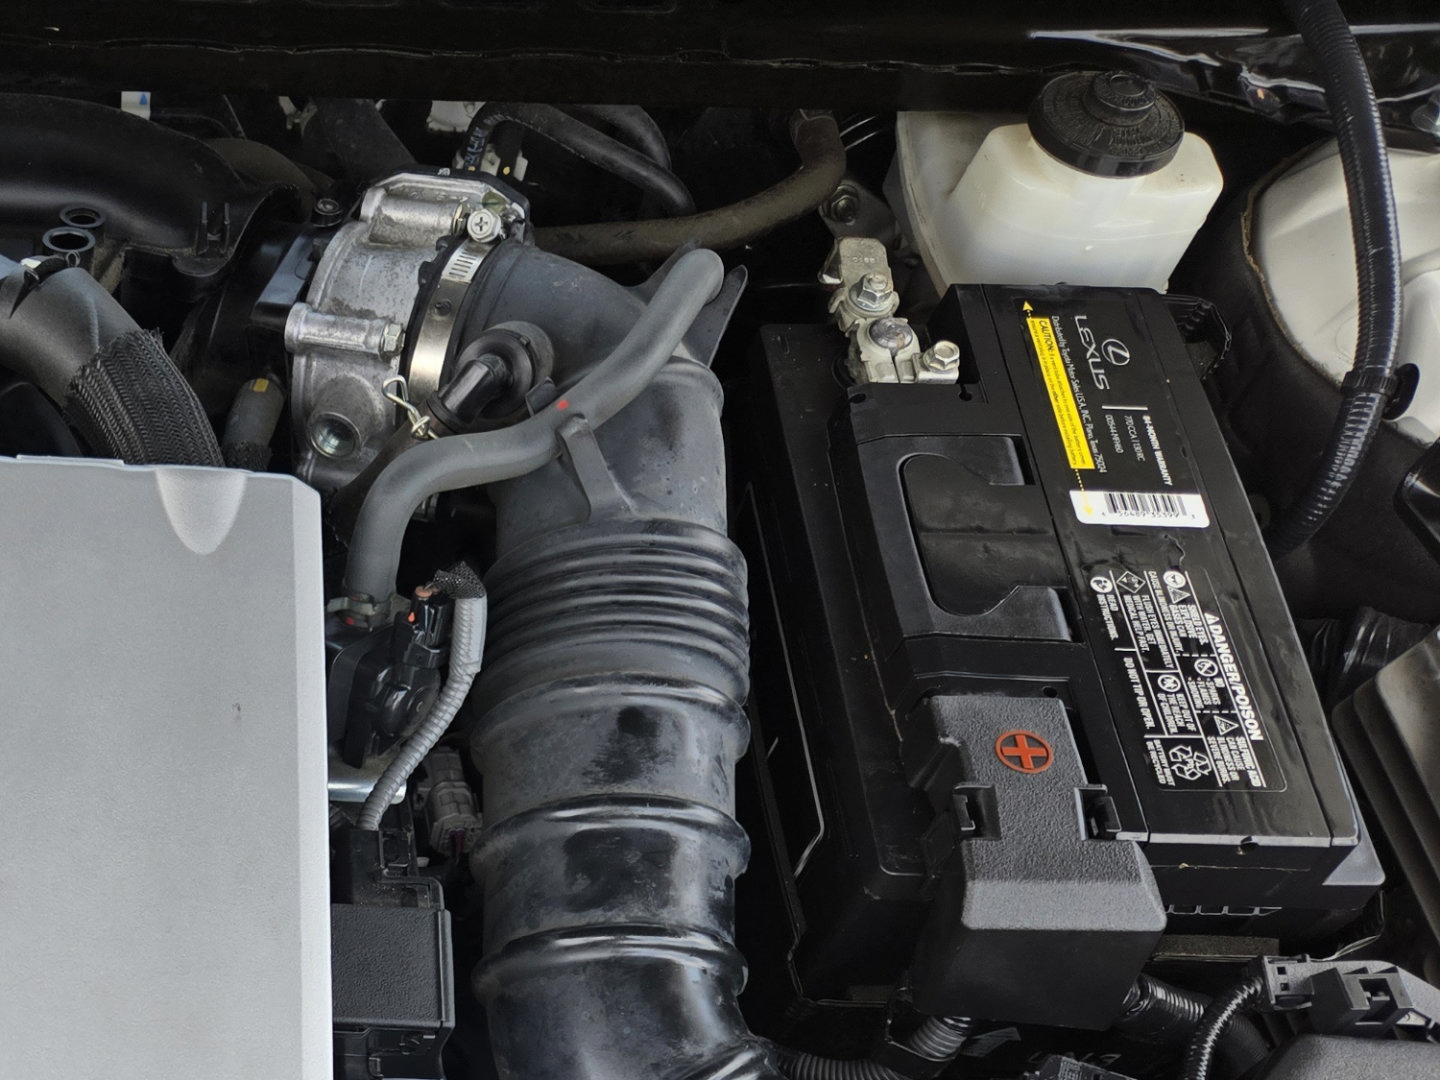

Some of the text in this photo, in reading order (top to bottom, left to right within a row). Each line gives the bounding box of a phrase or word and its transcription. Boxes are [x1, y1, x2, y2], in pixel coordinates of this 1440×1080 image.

[1037, 320, 1056, 352] CAUTION:
[1073, 315, 1109, 389] LEXUS
[1059, 348, 1073, 363] Toyota
[1065, 363, 1078, 378] Motor
[1126, 425, 1138, 439] CCA
[1093, 453, 1107, 472] 75024
[1153, 450, 1173, 486] WARRANTY
[1105, 594, 1119, 611] READ
[1147, 571, 1161, 589] CAUSE
[1154, 590, 1173, 620] BLINDNESS
[1121, 594, 1150, 652] MEDICAL HELP FAST.
[1131, 594, 1144, 609] WITH
[1145, 633, 1156, 644] GET
[1168, 604, 1188, 636] GASES CAN
[1177, 604, 1197, 638] EXPLOSIVE
[1187, 604, 1202, 625] SHIELD
[1140, 594, 1174, 668] FLUSH EYES IMMEDIATELY
[1122, 657, 1157, 729] DO NOT TIP OR OPEN.
[1186, 681, 1204, 708] SMOKING
[1196, 681, 1212, 704] FLAMES
[1205, 681, 1221, 704] SPARKS
[1208, 624, 1264, 740] DANGER/POISON
[1213, 677, 1225, 687] NO
[1165, 694, 1185, 726] THE REACH
[1175, 693, 1189, 708] KEEP
[1181, 709, 1193, 722] OUT
[1152, 739, 1176, 786] BATTERY MUST
[1206, 736, 1223, 759] SEVERE
[1216, 736, 1236, 770] BLINDNESS
[1225, 736, 1245, 770] CAN CAUSE
[1234, 736, 1262, 786] SULFURIC ACID
[1148, 750, 1167, 783] RECYCLED
